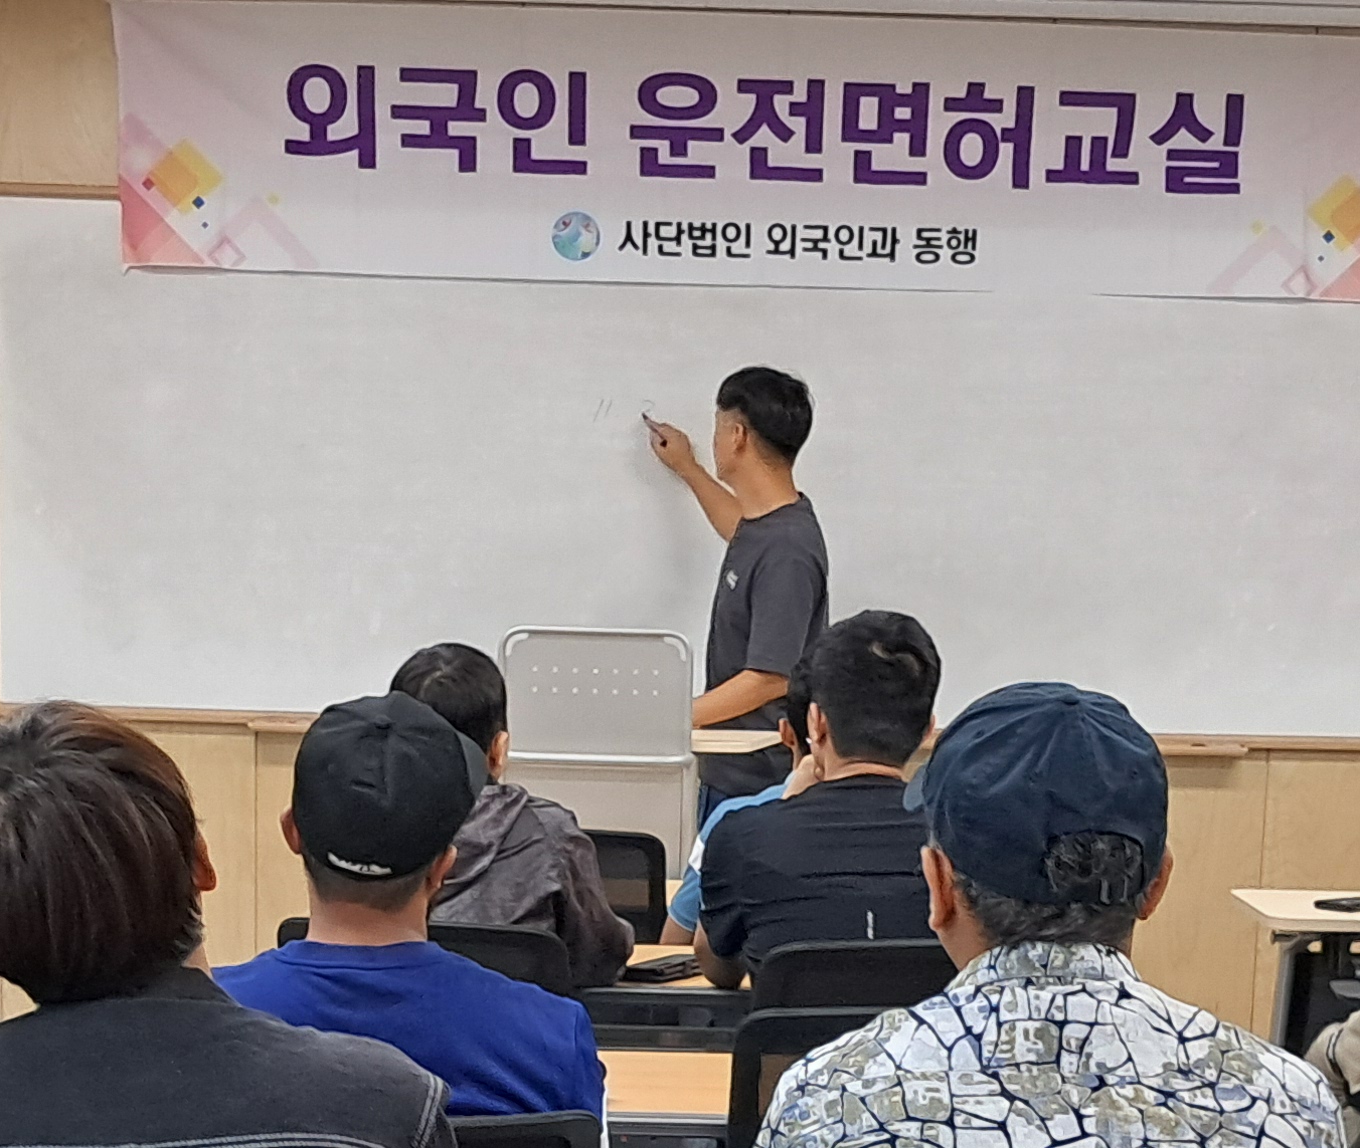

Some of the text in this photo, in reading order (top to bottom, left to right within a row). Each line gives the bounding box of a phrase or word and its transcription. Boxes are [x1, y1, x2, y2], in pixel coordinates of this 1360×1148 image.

[283, 62, 1247, 196] 외국인 운전면허교실
[617, 219, 979, 267] 사단법인 외국인과 동행
